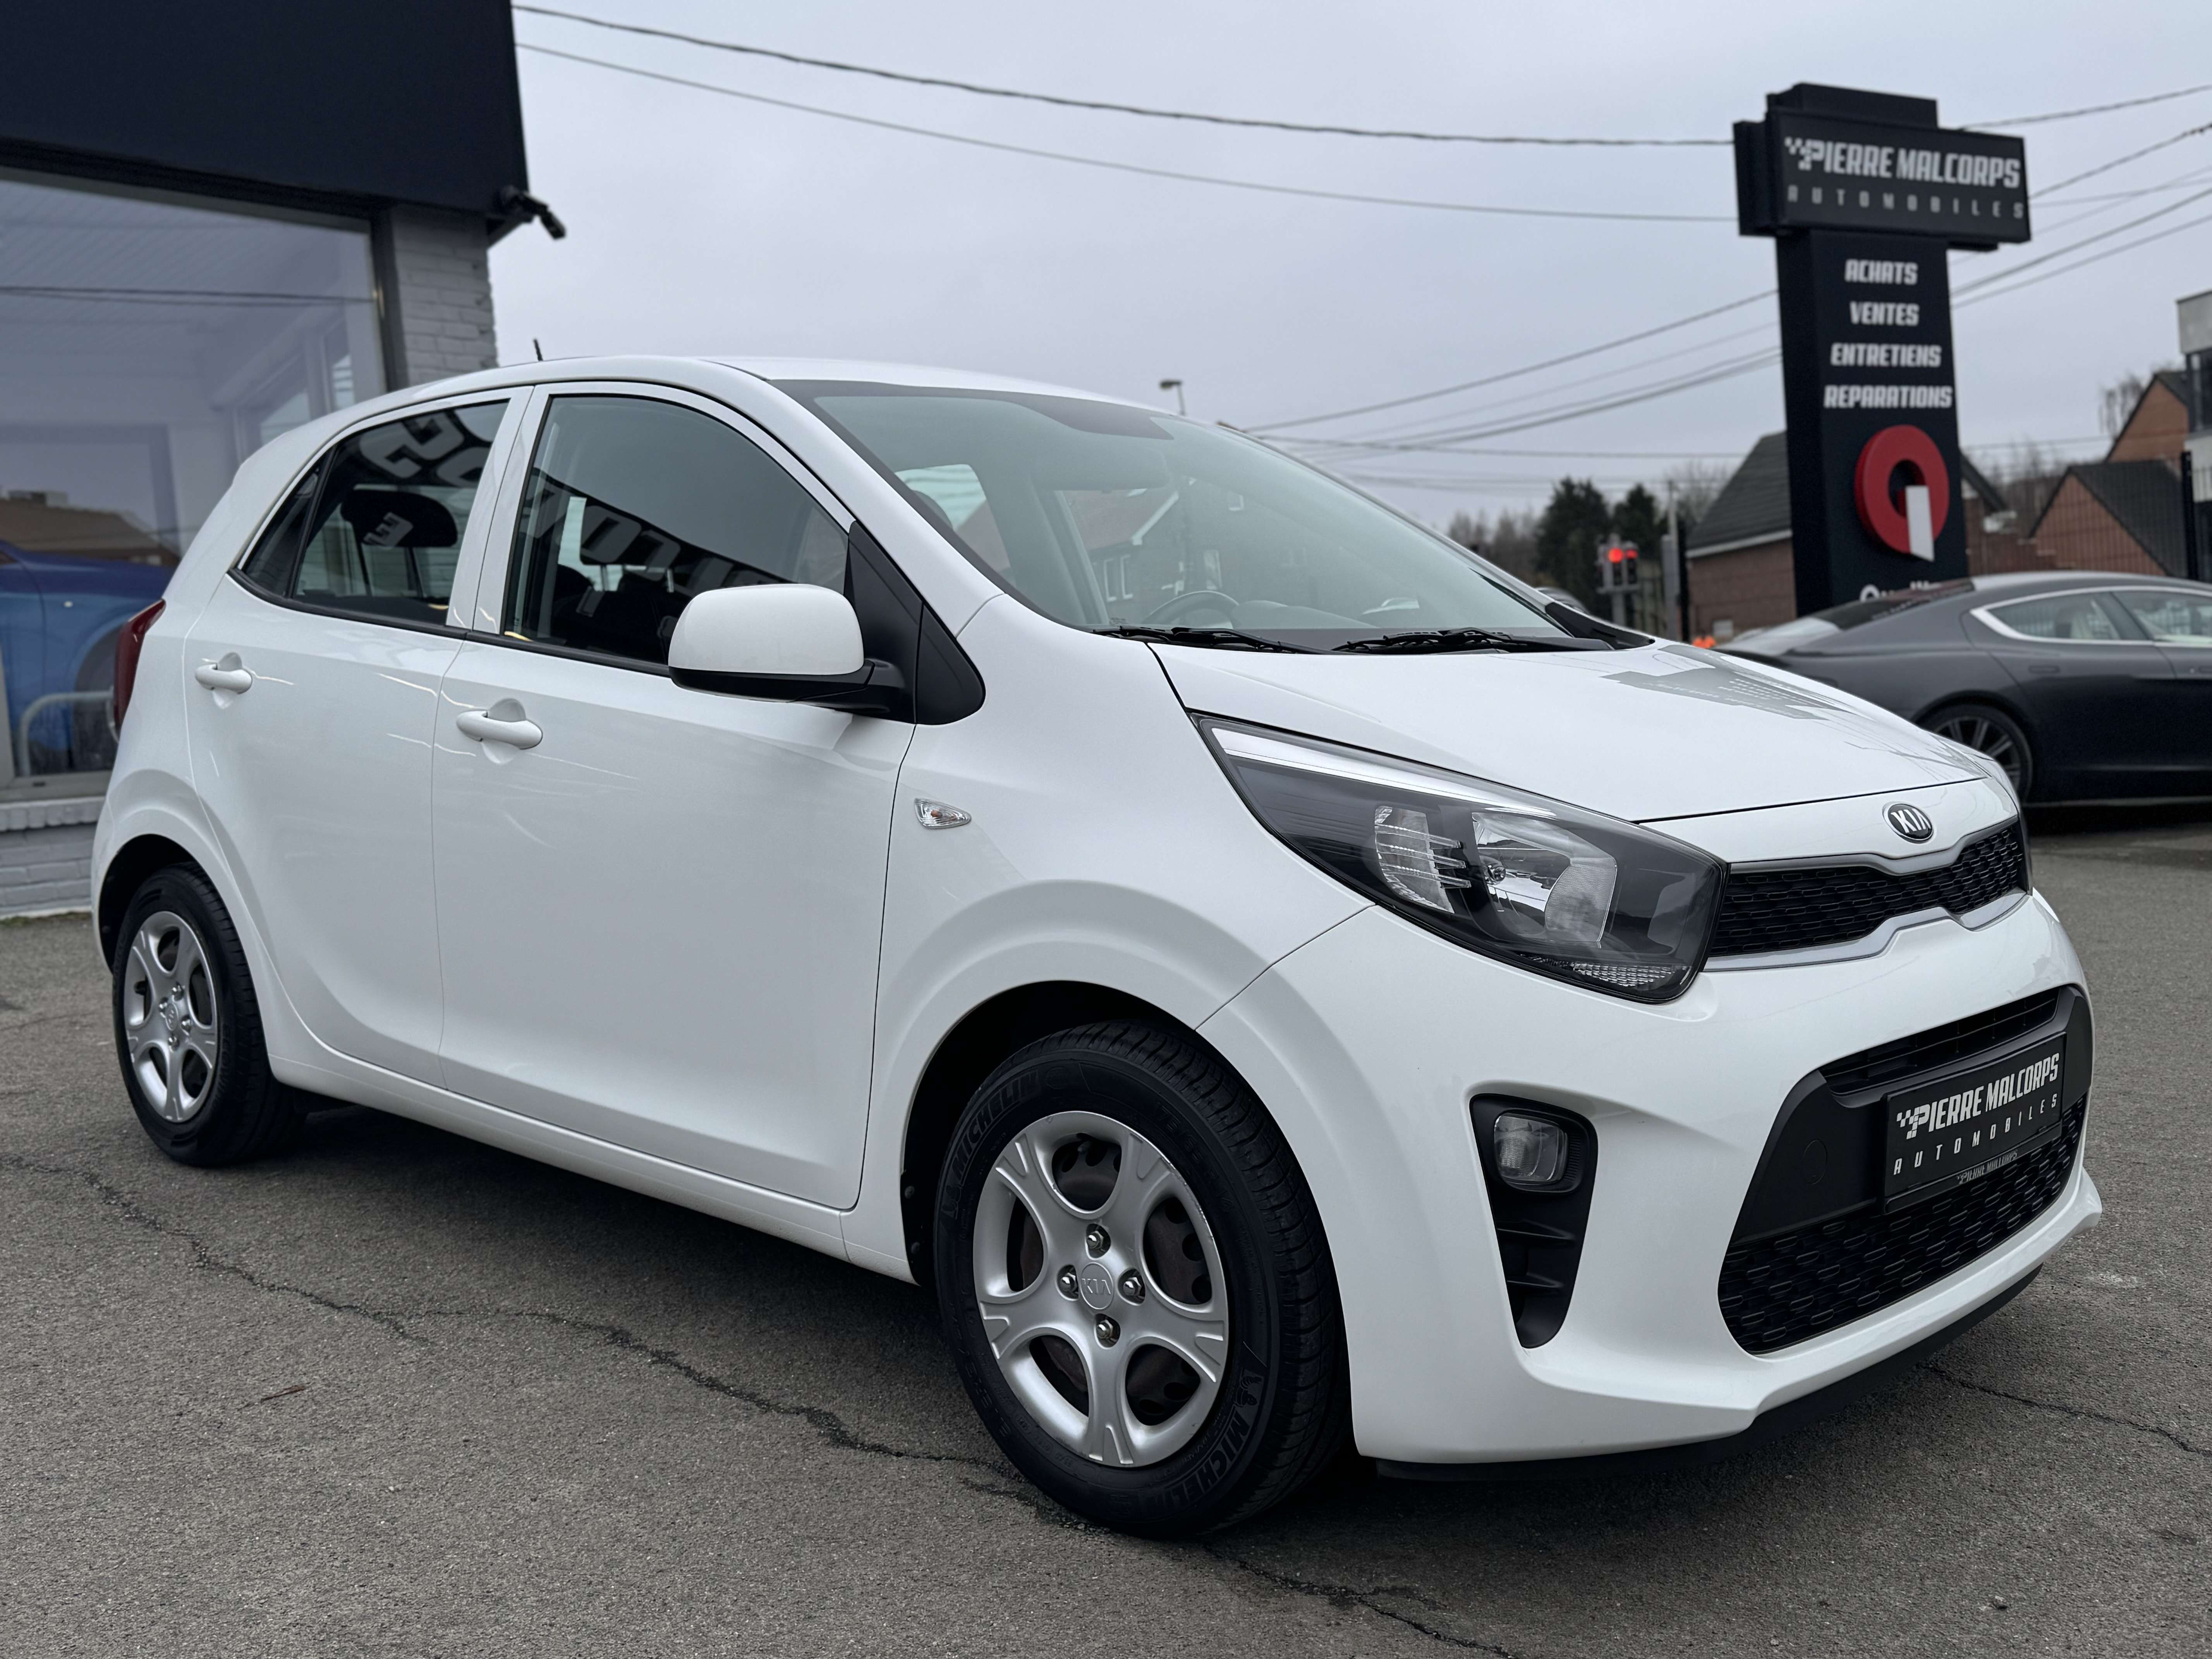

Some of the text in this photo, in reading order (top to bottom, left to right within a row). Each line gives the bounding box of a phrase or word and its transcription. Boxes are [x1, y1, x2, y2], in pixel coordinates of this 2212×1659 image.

[1796, 139, 2020, 188] PIERRE MALCORPS
[1788, 185, 2023, 219] AUTOMOBILES
[1844, 259, 1918, 285] ACHATS
[1849, 301, 1920, 326] VENTES
[1830, 342, 1942, 368] ENTRETIENS
[1823, 385, 1953, 409] REPARATIONS
[1890, 807, 1932, 833] KIA
[1902, 1052, 2060, 1139] PIERRE MALCORPS
[950, 1066, 1041, 1182] MICHELIN
[1893, 1093, 2057, 1175] AUTOMOBILES
[1081, 1278, 1111, 1294] KIA
